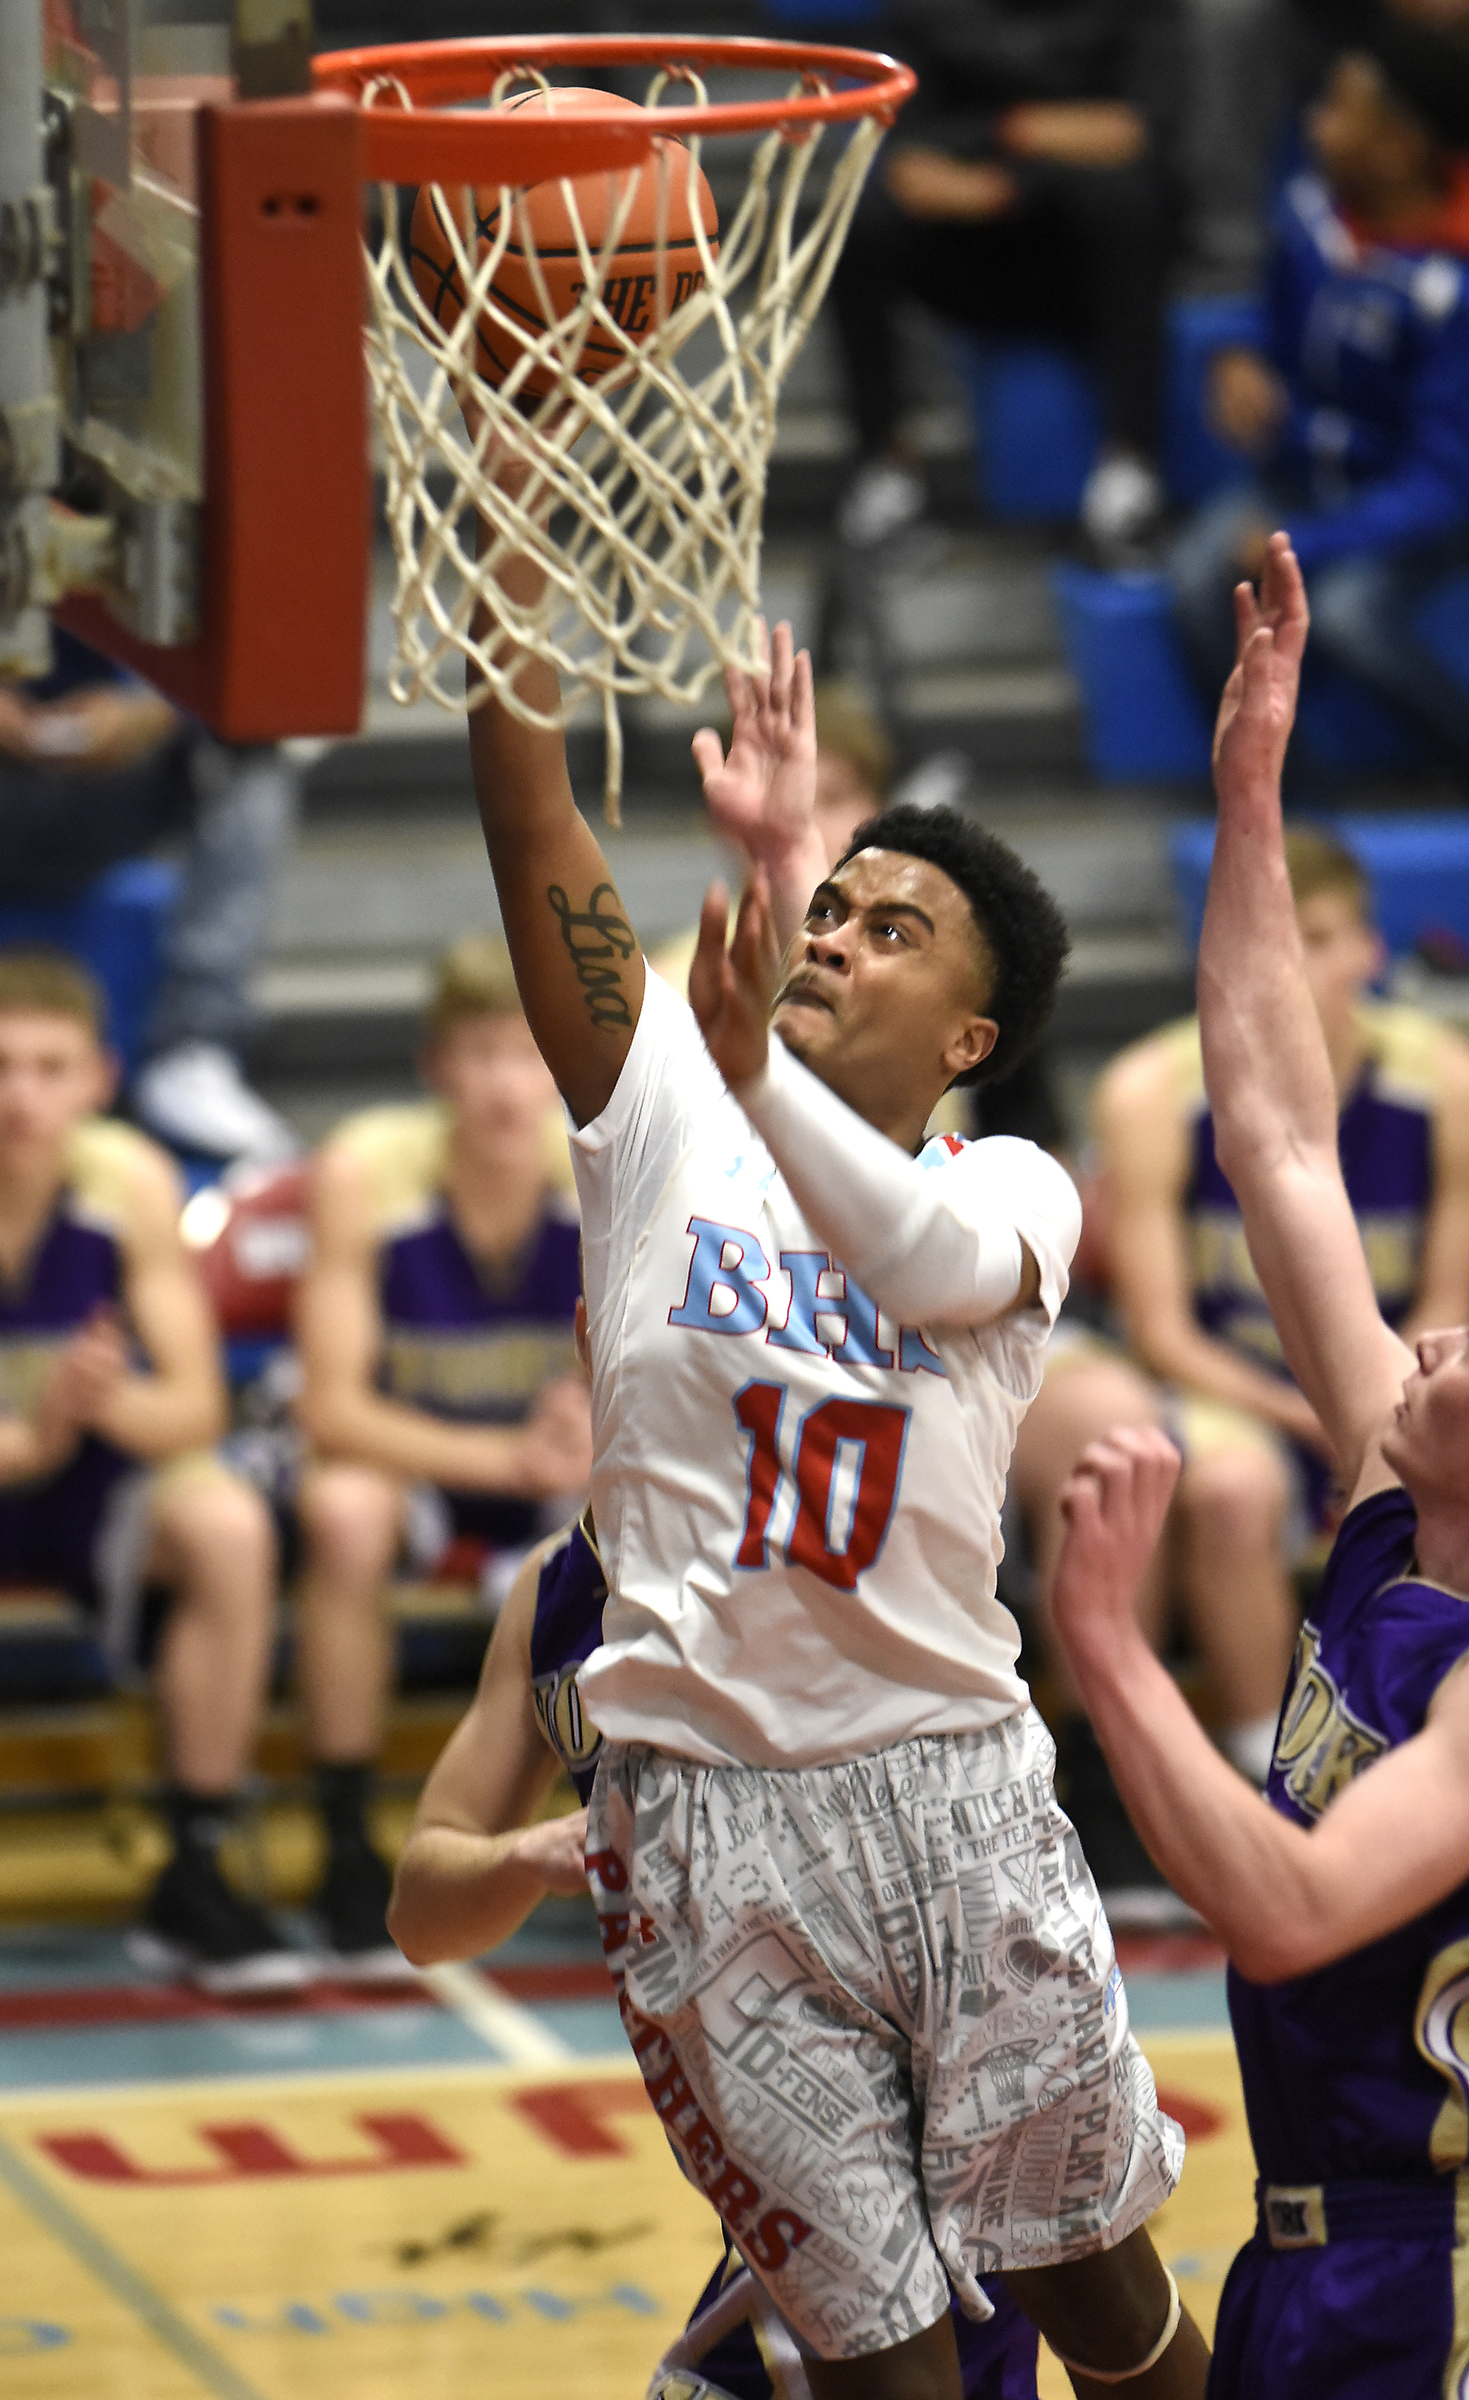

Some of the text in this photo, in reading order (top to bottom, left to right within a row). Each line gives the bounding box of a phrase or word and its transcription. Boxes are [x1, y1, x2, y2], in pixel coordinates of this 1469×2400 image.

[548, 882, 636, 1033] Lisa
[668, 1215, 948, 1379] BH
[732, 1377, 914, 1595] 10
[1002, 1821, 1034, 1847] TEA
[584, 1848, 815, 2272] PATHERS
[736, 2030, 854, 2139] D-FENSE
